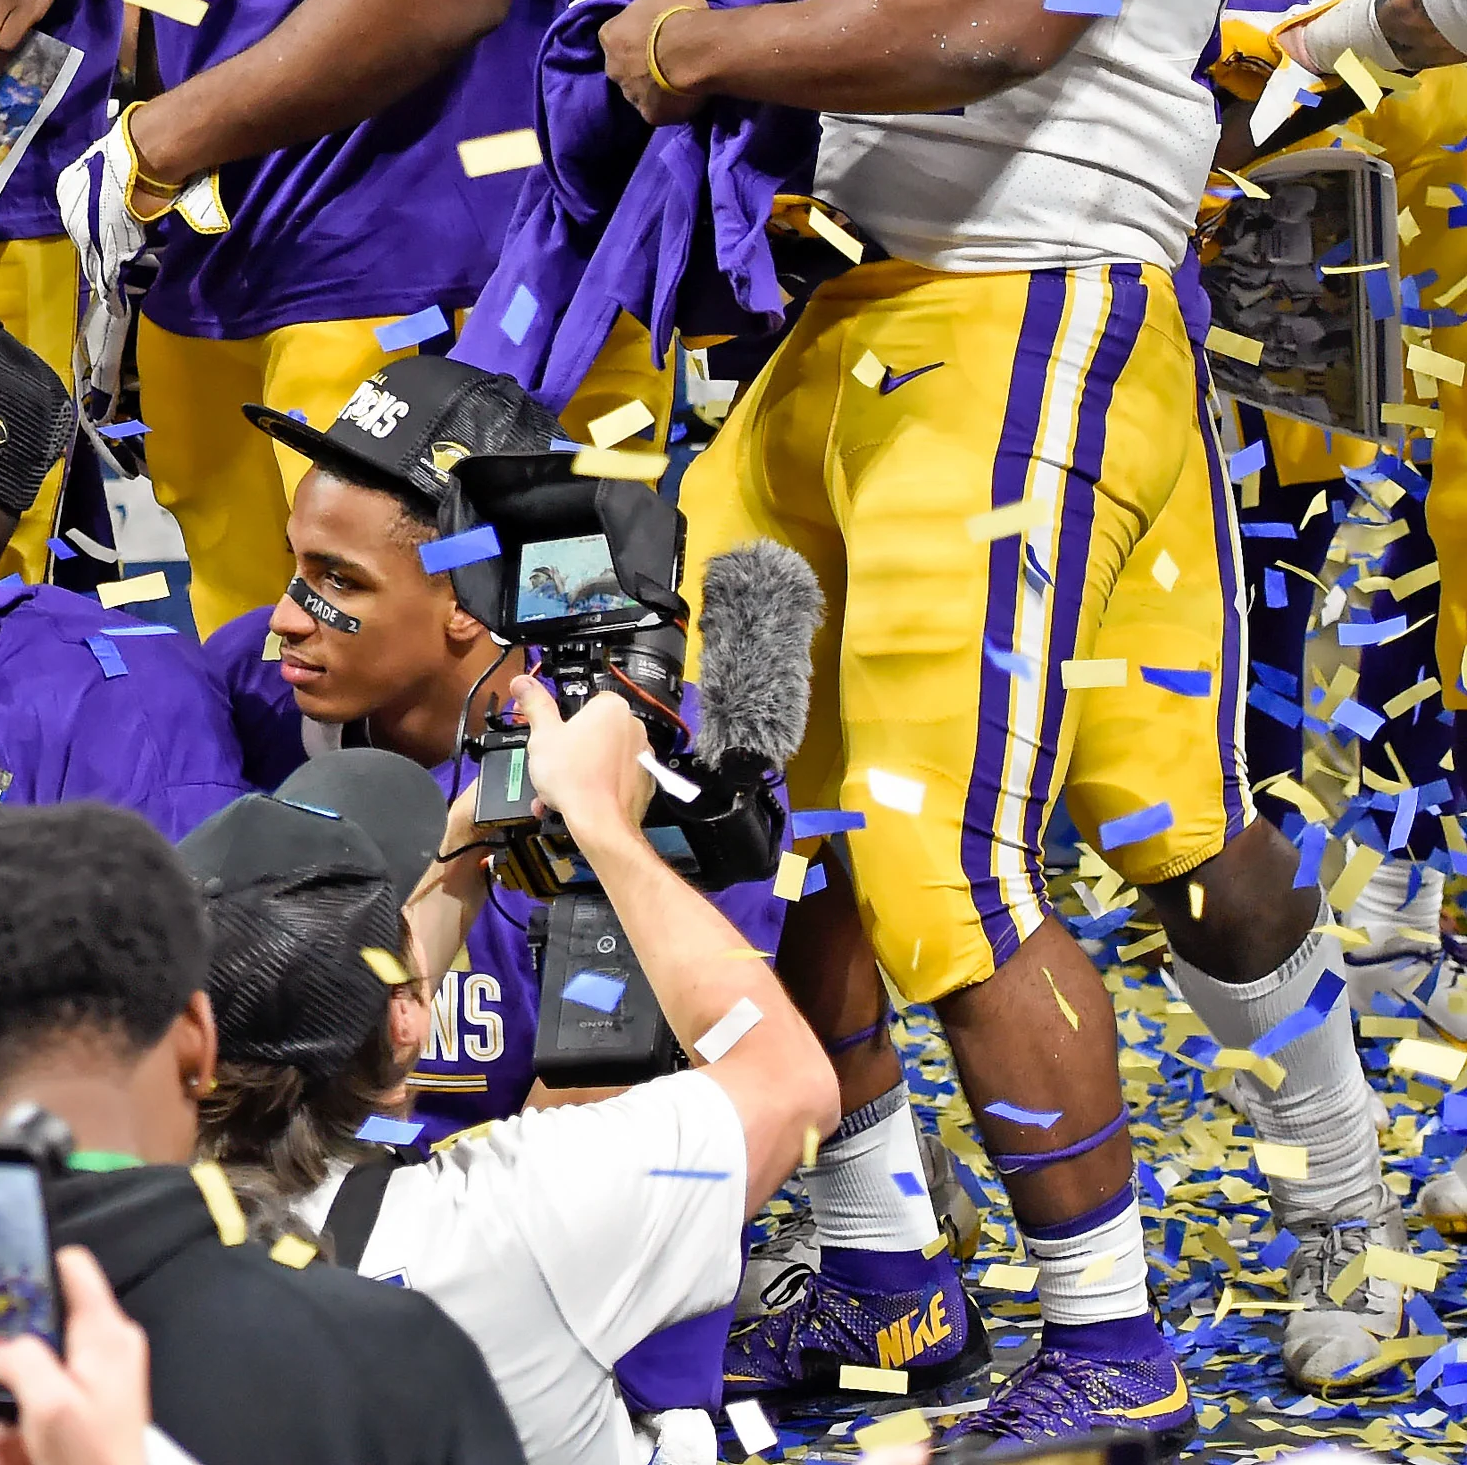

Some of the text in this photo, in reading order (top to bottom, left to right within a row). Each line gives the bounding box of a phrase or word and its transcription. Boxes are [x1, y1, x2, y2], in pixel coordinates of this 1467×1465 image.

[304, 594, 359, 633] MADE 2
[876, 1289, 953, 1370] NIKE
